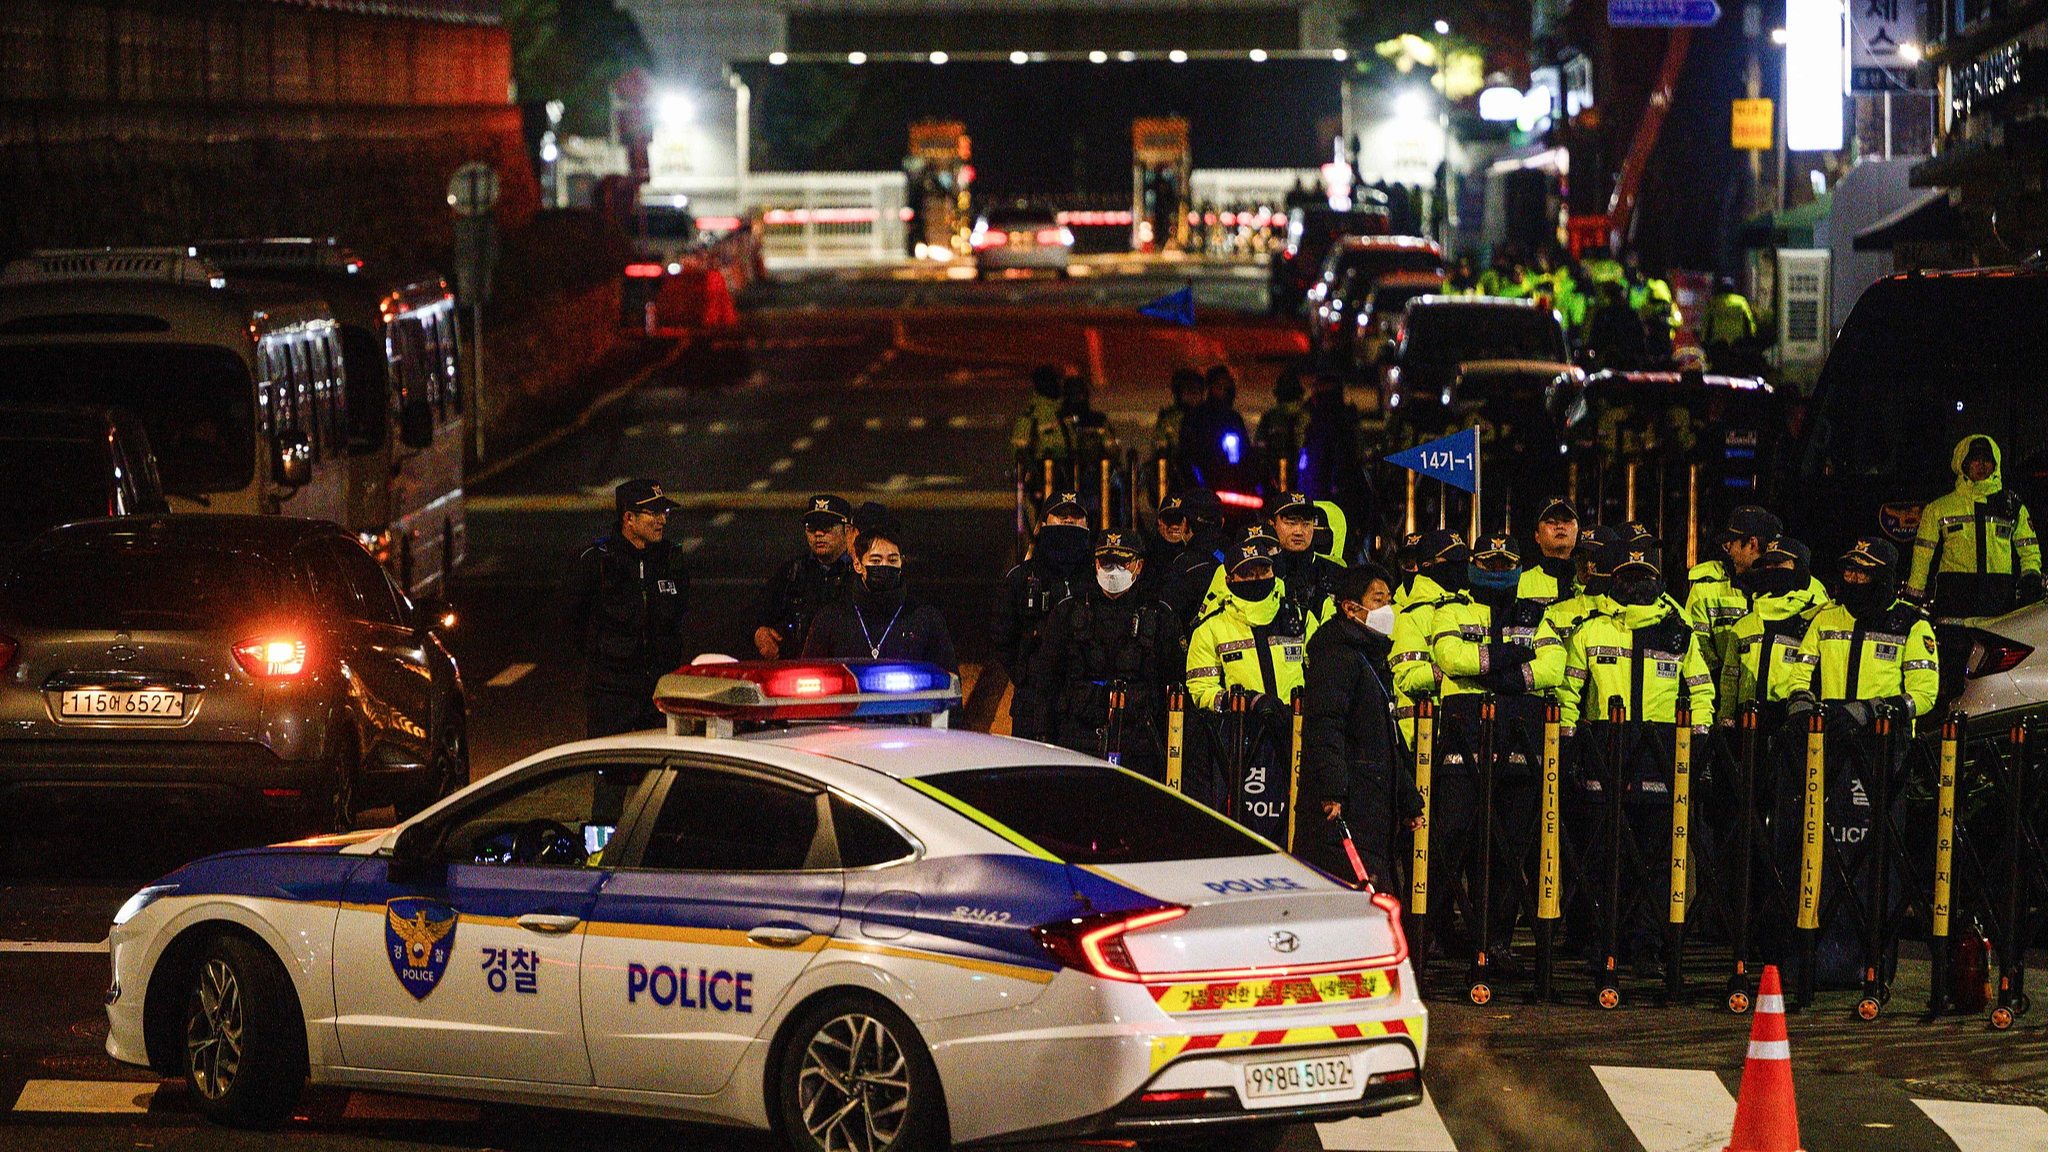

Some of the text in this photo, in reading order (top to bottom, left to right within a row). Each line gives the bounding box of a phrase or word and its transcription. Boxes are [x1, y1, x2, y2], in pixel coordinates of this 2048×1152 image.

[1420, 450, 1473, 471] 14기-1
[125, 694, 175, 713] 6527
[1544, 757, 1557, 899] POLICE LINE
[1672, 761, 1688, 903] 질서유지선
[1803, 768, 1818, 909] POLICE LINE
[1935, 774, 1953, 917] 질서유지선
[1202, 876, 1308, 895] POLICE
[402, 968, 434, 982] POLICE
[481, 948, 540, 994] 경찰
[628, 962, 753, 1014] POLICE
[1182, 987, 1208, 1006] 가장
[1213, 986, 1250, 1004] 안전한
[1304, 1060, 1348, 1087] 5032
